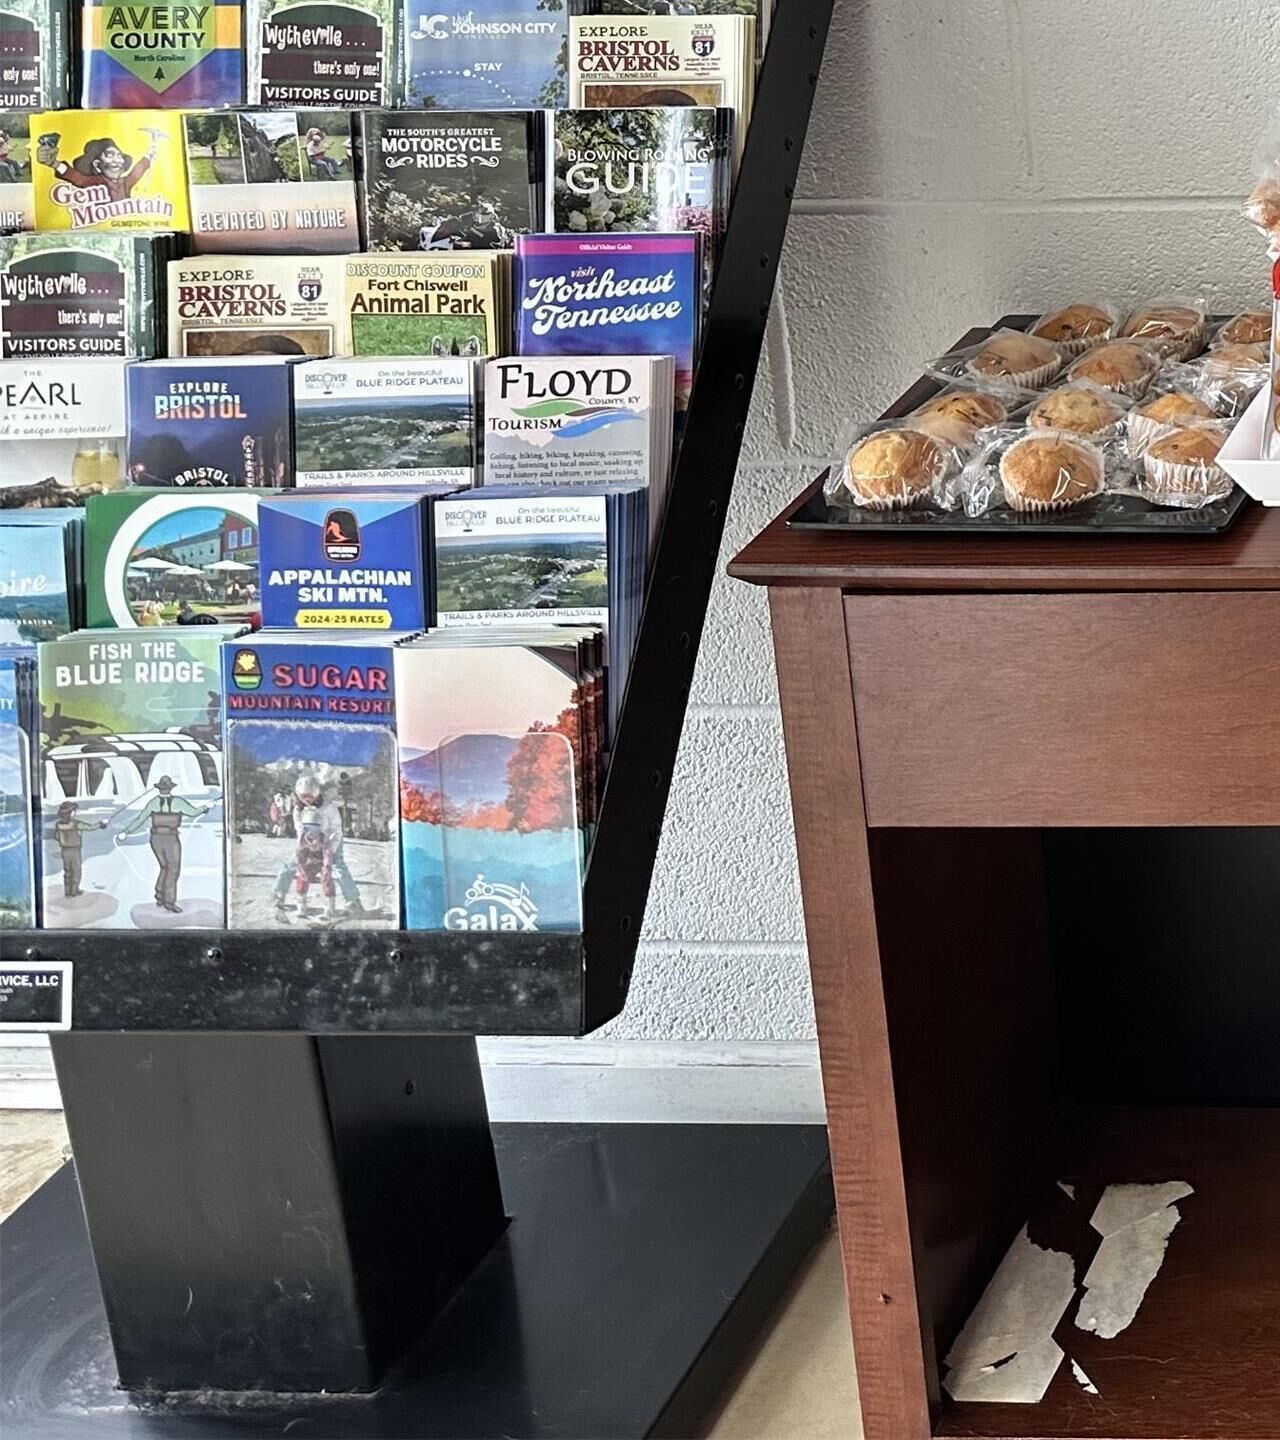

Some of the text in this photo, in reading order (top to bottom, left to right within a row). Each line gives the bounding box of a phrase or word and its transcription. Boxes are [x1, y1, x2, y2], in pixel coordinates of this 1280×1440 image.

[106, 6, 210, 30] AVERY
[452, 23, 557, 34] JOHNSON CITY
[579, 26, 648, 37] EXPLORE
[110, 33, 206, 49] COUNTY
[578, 40, 675, 56] BRISTOL
[694, 42, 712, 54] 81
[474, 62, 503, 71] STAY
[578, 55, 680, 72] CAVERNS
[264, 87, 378, 102] VISITORS GUIDE
[387, 128, 495, 136] THE SOUTH'S GREATEST
[381, 137, 503, 152] MOTORCYCLE
[416, 154, 469, 168] RIDES
[567, 149, 639, 161] BLOWING
[565, 162, 709, 194] GUIDE
[51, 183, 110, 205] Gem
[72, 195, 174, 228] Mountain
[200, 209, 346, 231] ELEVATED BY NATURE
[179, 270, 254, 282] EXPLORE
[346, 264, 486, 278] DISCOUNT COUPON
[571, 266, 596, 278] visit
[301, 286, 319, 298] 81
[368, 279, 468, 291] Fort Chiswell
[522, 268, 676, 310] Northeast
[178, 284, 281, 302] BRISTOL
[178, 300, 287, 318] CAVERNS
[351, 293, 430, 313] Animal
[437, 294, 486, 314] Park
[532, 300, 682, 335] Tennessee
[7, 339, 123, 352] VISITORS GUIDE
[170, 382, 228, 393] EXPLORE
[356, 377, 464, 387] BLUE RIDGE PLATEAU
[497, 364, 632, 399] FLOYD
[0, 382, 81, 407] EARL
[628, 396, 641, 404] KY
[155, 395, 247, 419] BRISTOL
[489, 417, 563, 431] TOURISM
[174, 467, 229, 486] BRISTOL
[304, 468, 465, 480] TRAILS PARKS AROUND HILLSVILLE
[496, 514, 601, 525] BLUE RIDGE PLATEAU
[268, 569, 412, 586] APPALACHIAN
[298, 588, 389, 603] SKI MTN.
[303, 615, 385, 624] 2024-25 RATES
[443, 610, 554, 620] TRAILS PARKS AROUND
[89, 642, 176, 661] FISH THE
[56, 662, 205, 687] BLUE RIDGE
[272, 664, 389, 691] SUGAR
[229, 694, 394, 714] MOUNTAIN RESORT
[443, 905, 540, 931] Galax
[35, 975, 59, 986] LLC
